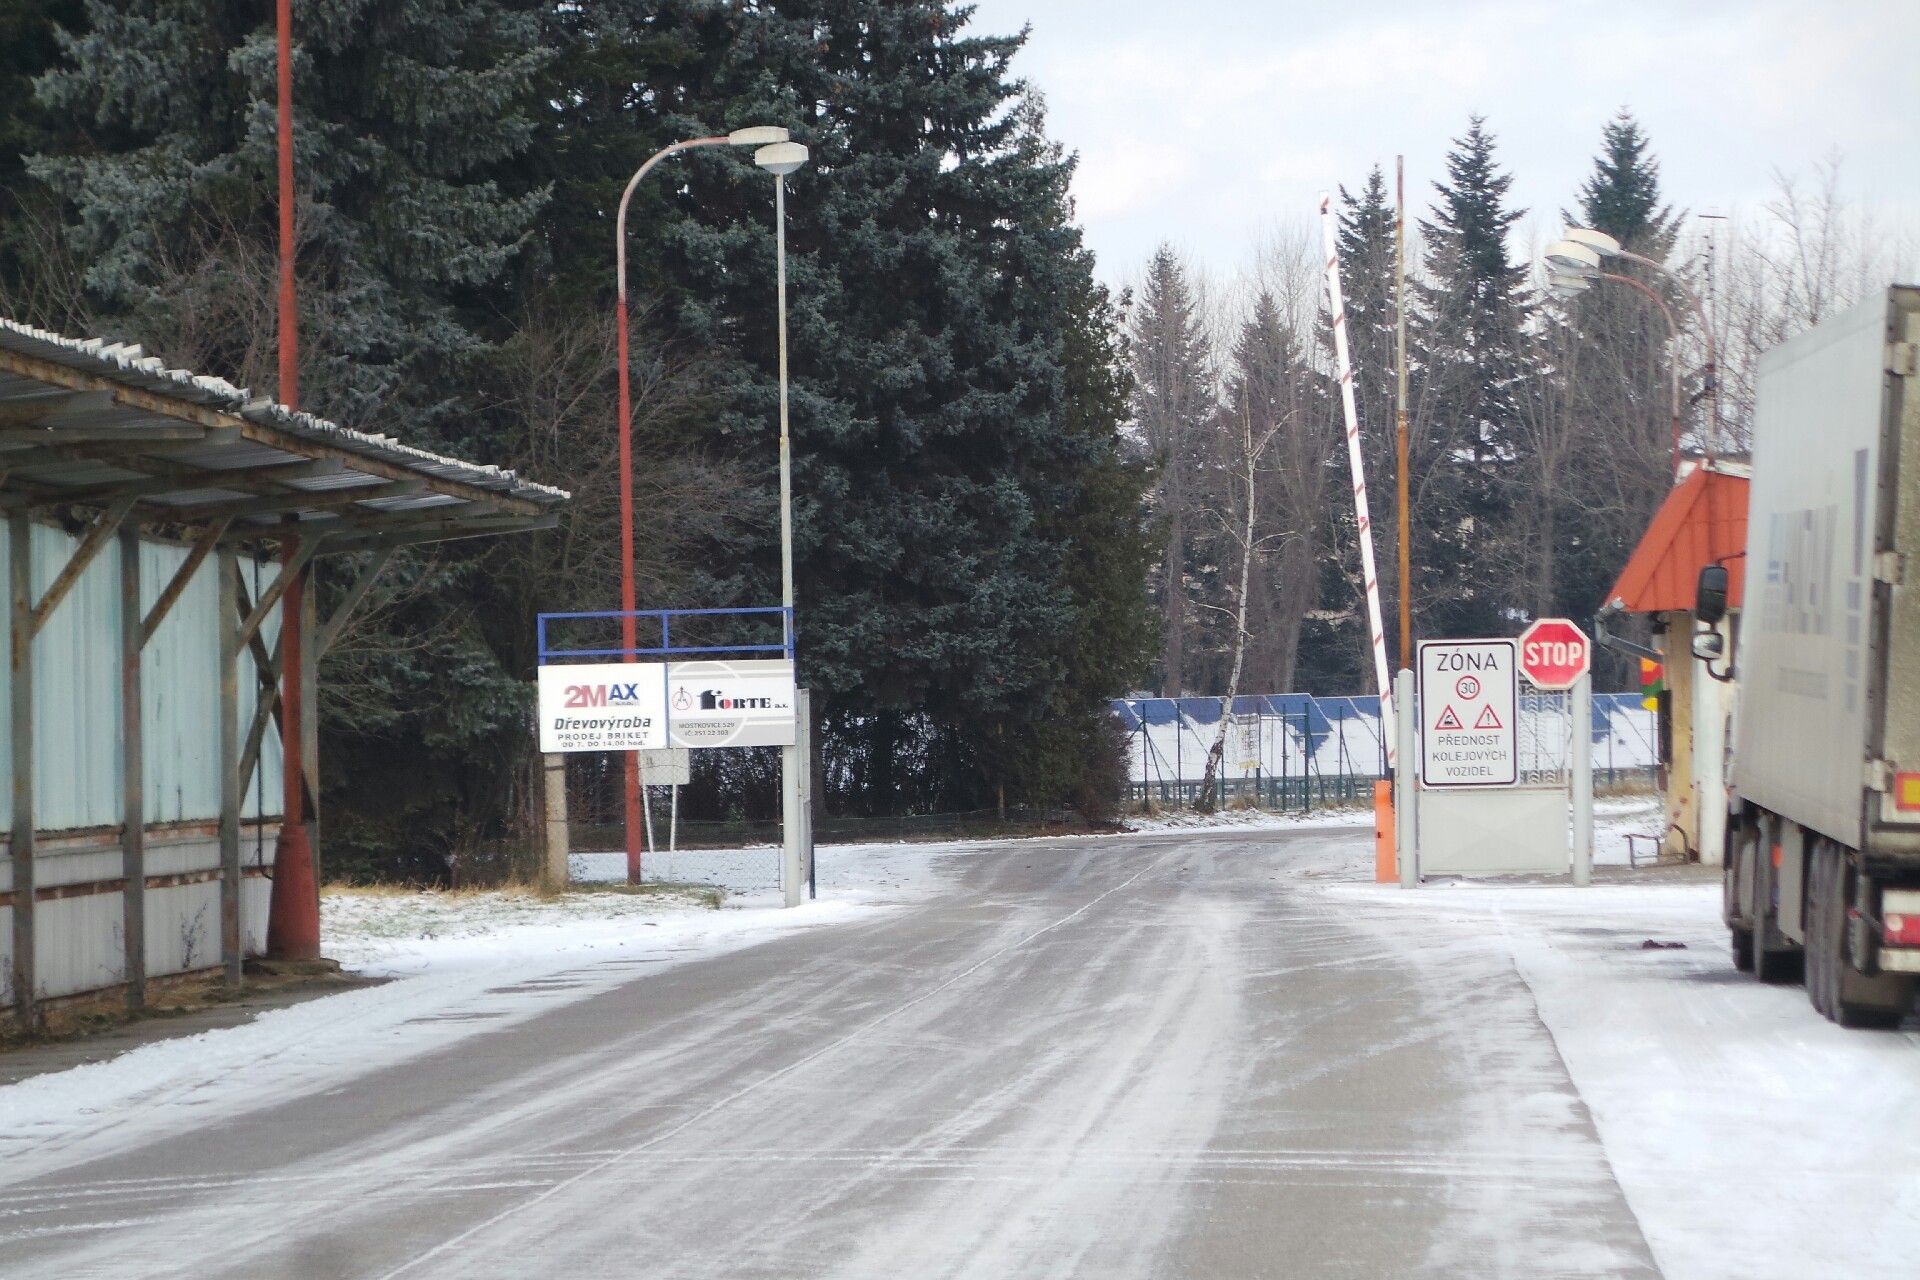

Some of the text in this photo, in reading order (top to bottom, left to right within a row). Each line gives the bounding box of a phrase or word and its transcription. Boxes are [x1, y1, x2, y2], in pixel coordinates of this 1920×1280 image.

[1436, 648, 1499, 671] ZÓNA
[1526, 642, 1583, 666] STOP
[1460, 682, 1476, 694] 30
[563, 683, 639, 708] 2MAX
[554, 716, 651, 731] Dřevovýroba
[557, 731, 649, 741] PRODEJ BRIKET
[1438, 734, 1500, 746] PŘEDNOST
[1432, 748, 1507, 762] KOLEJOVÝCH
[1445, 766, 1494, 777] VOZIDEL
